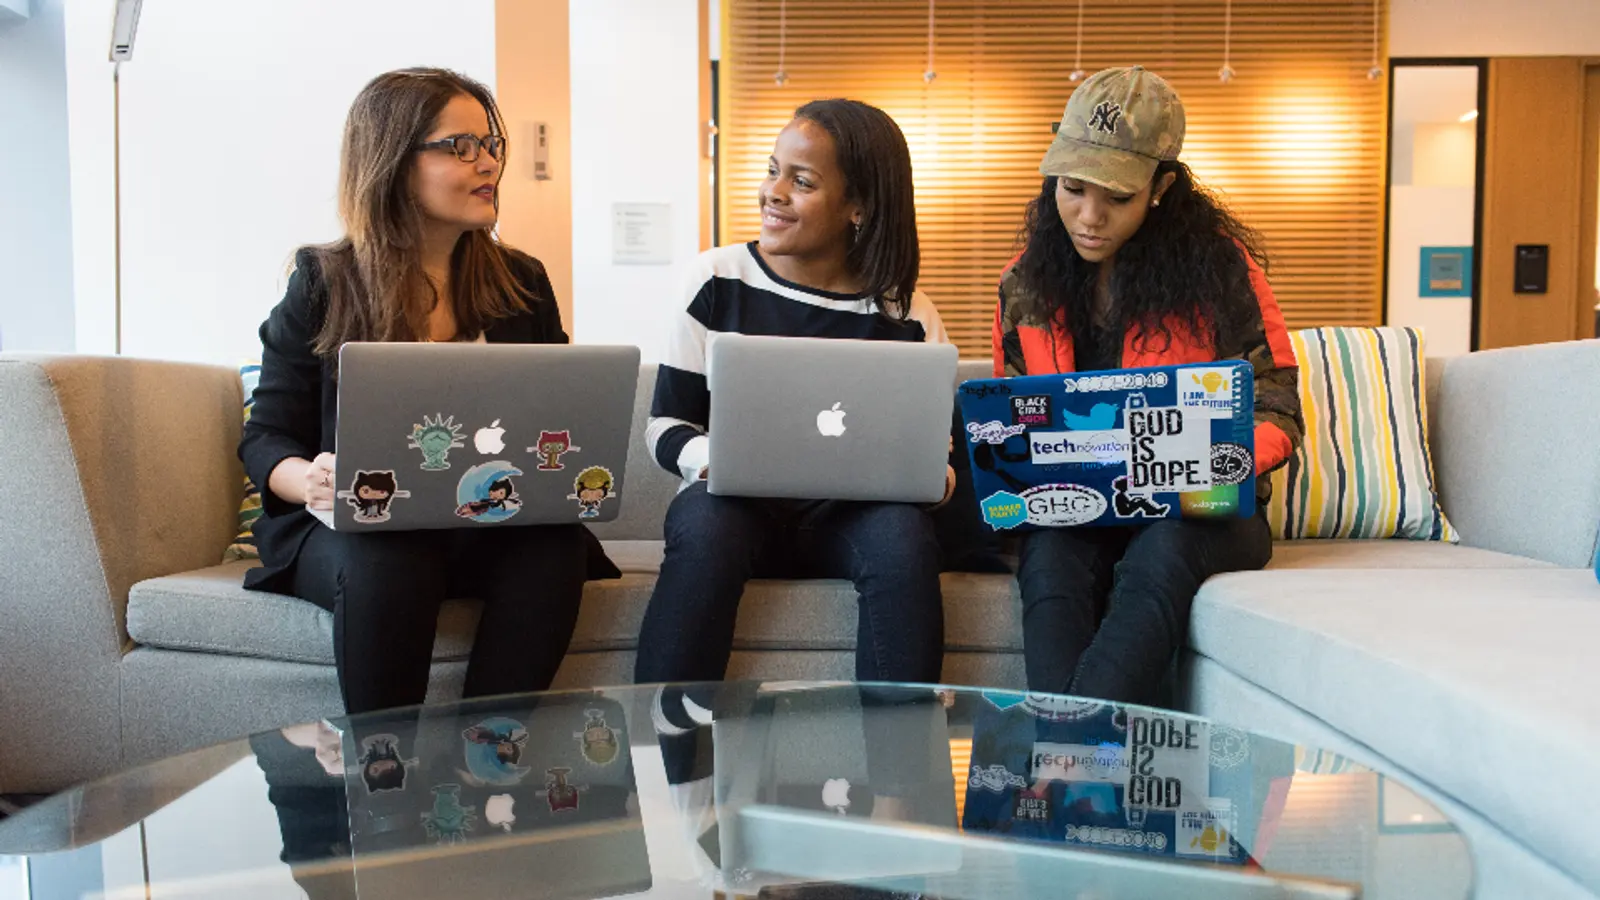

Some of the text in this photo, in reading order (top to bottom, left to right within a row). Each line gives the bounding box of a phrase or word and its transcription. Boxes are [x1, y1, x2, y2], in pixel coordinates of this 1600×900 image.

[1088, 101, 1122, 134] NY
[1015, 396, 1048, 408] BLACK
[1018, 406, 1046, 416] GIRLS
[1129, 409, 1183, 438] GOD
[1032, 438, 1130, 454] technovation
[1131, 437, 1155, 463] IS
[1132, 460, 1208, 488] DOPE.
